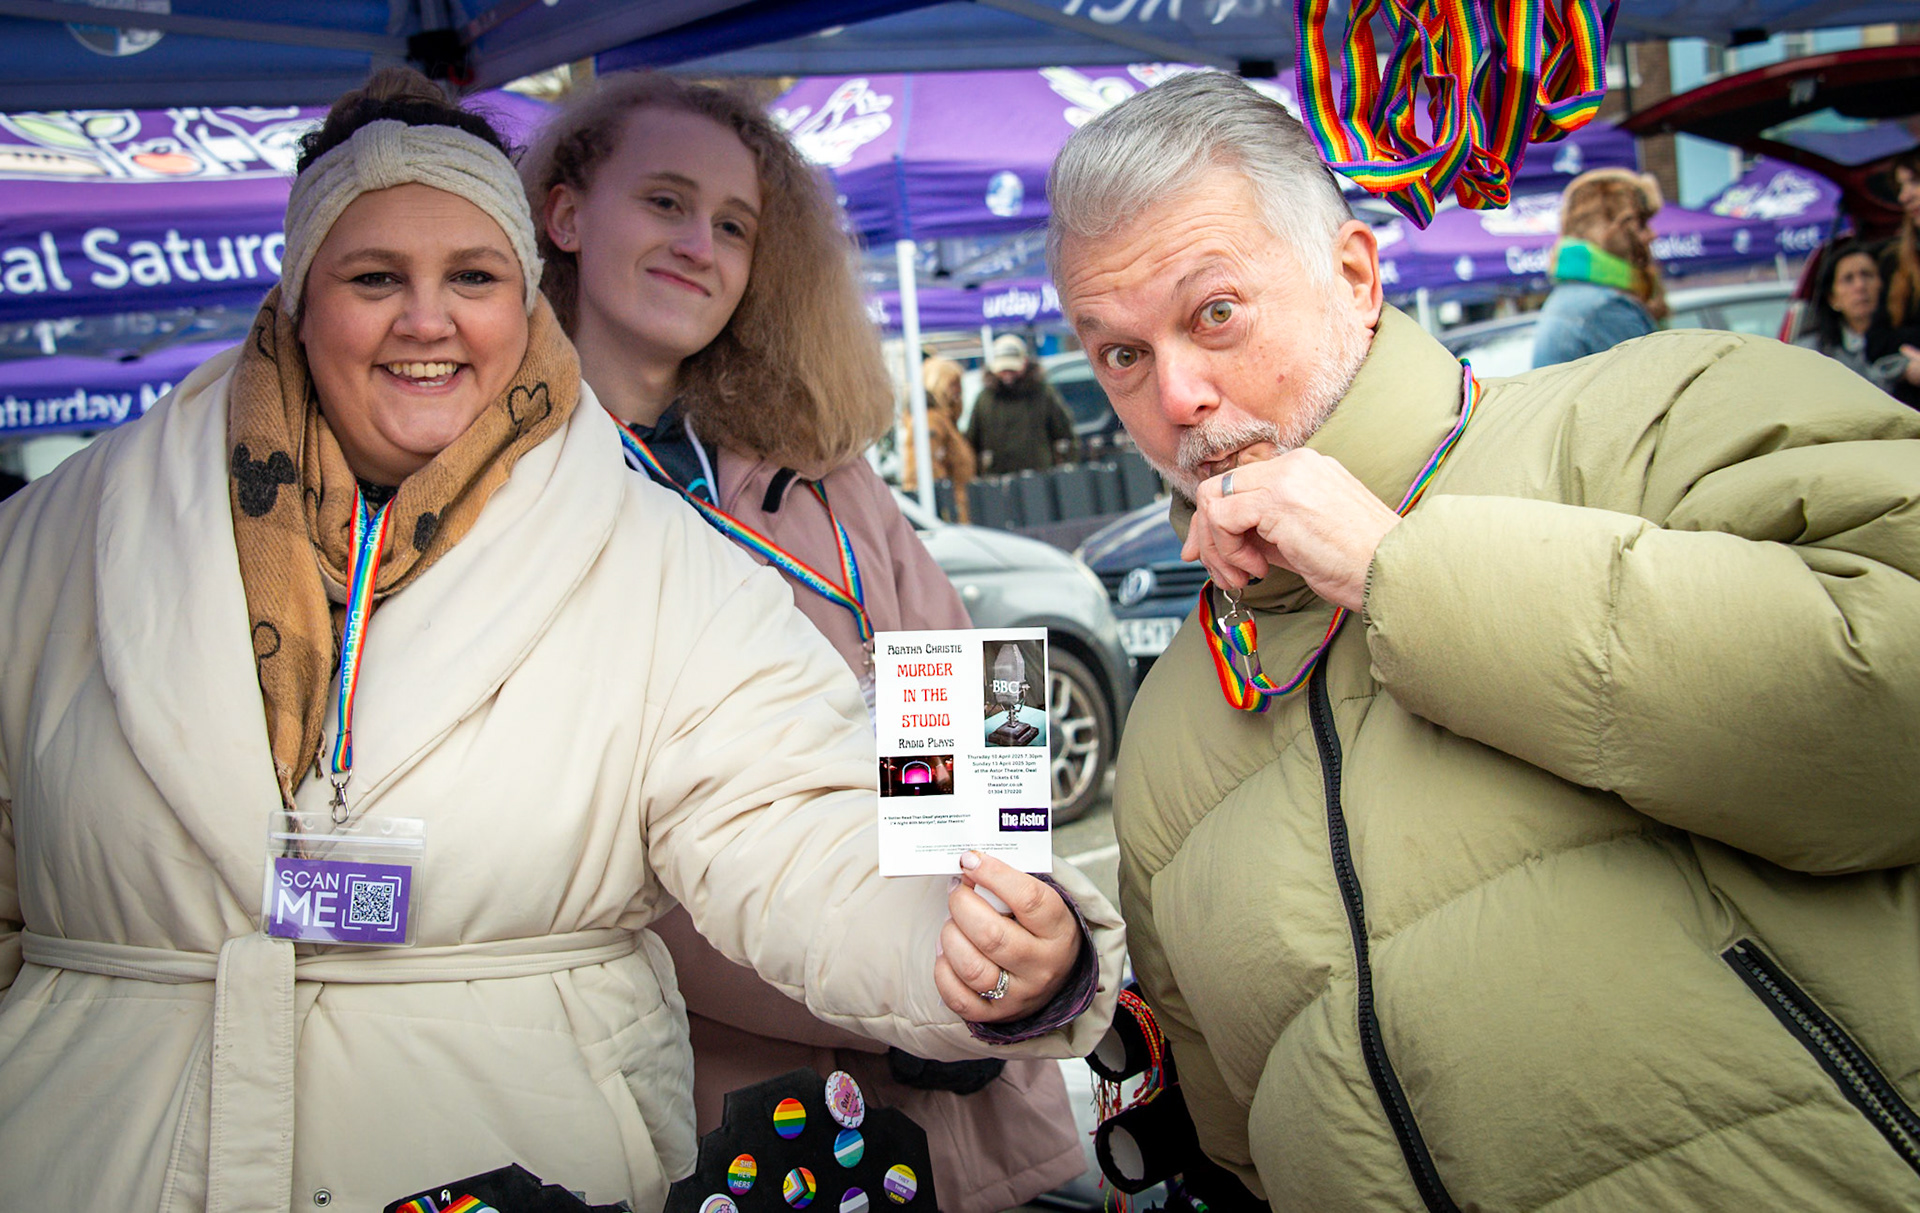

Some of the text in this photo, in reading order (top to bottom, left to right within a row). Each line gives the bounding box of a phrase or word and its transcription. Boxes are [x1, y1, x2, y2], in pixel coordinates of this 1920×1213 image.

[0, 231, 72, 294] al
[0, 388, 132, 428] turday
[342, 610, 364, 695] DEAL PRIDE
[897, 663, 953, 677] MURDER
[993, 680, 1020, 693] BBC
[903, 688, 948, 702] IN THE
[902, 713, 950, 728] STUDIO
[1001, 812, 1046, 826] the Astor
[280, 870, 340, 890] SCAN
[276, 889, 338, 928] ME
[740, 1160, 753, 1168] SHE
[733, 1180, 751, 1189] HERS
[898, 1174, 909, 1183] THEY
[895, 1184, 907, 1194] THEM
